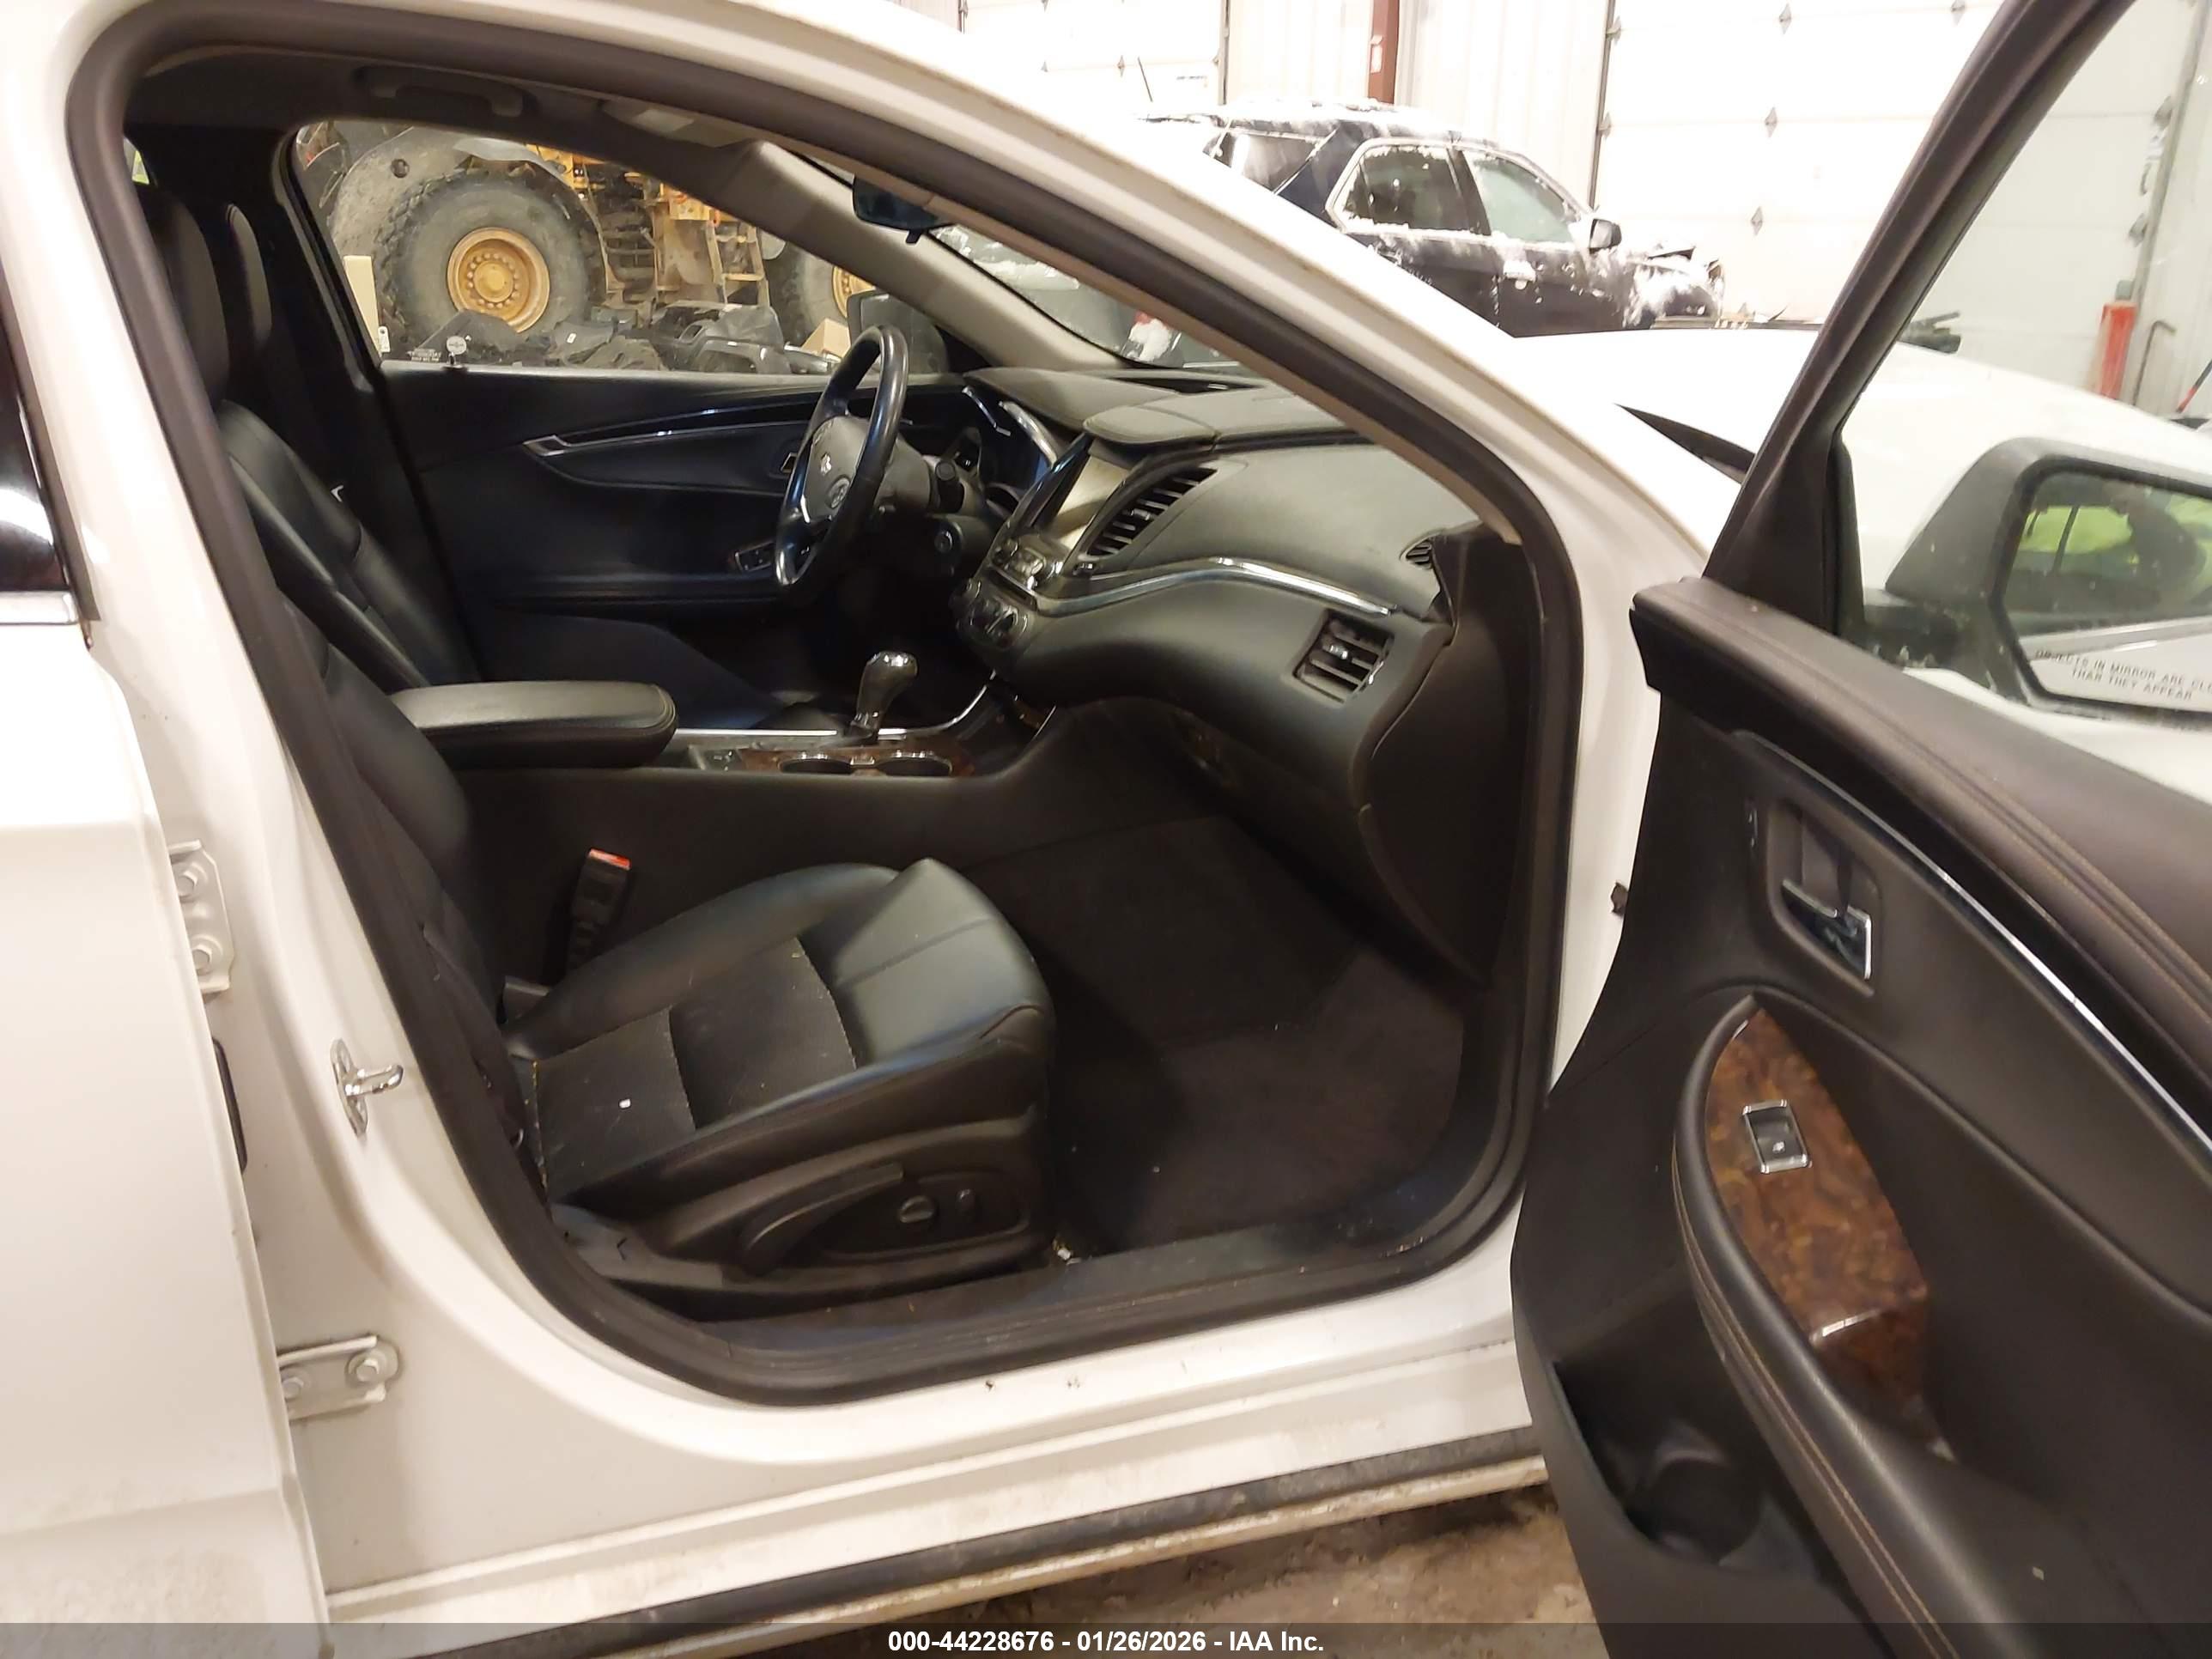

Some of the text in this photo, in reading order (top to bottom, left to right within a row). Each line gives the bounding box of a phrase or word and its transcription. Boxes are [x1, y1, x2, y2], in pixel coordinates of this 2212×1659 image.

[2072, 668, 2193, 700] THAN THEY APPEAR
[2094, 659, 2106, 668] IN
[2111, 663, 2156, 680] MIRROR
[2162, 673, 2185, 685] ARE
